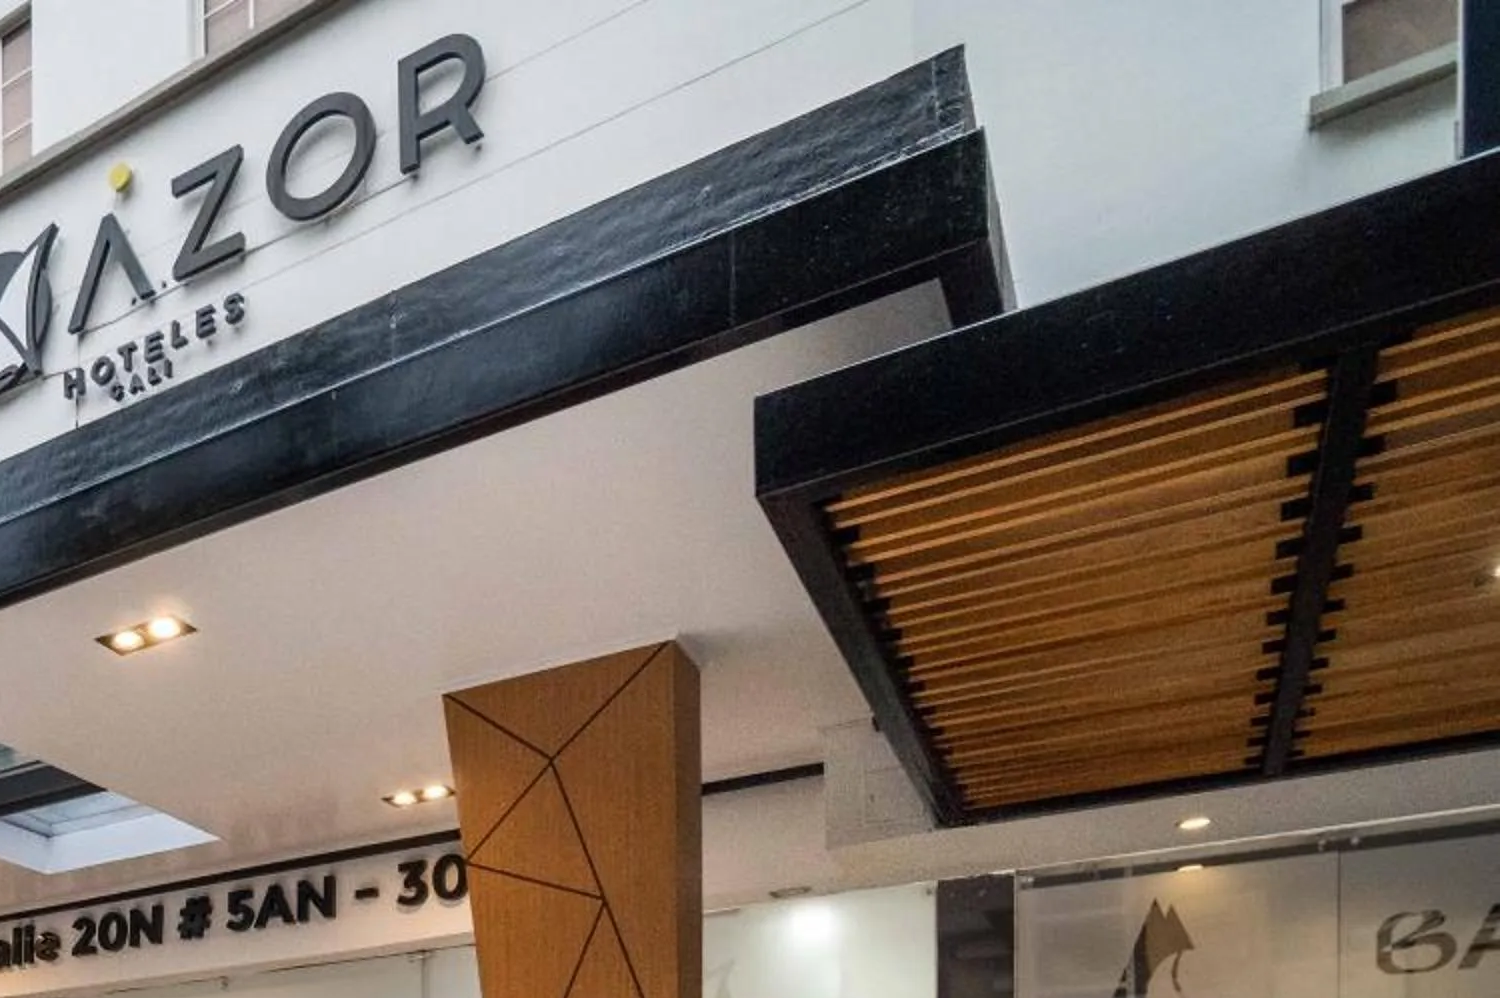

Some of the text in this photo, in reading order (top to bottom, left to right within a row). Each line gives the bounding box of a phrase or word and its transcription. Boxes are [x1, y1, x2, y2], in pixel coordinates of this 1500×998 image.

[64, 293, 245, 399] HOTELES
[110, 358, 173, 401] CALI
[71, 904, 164, 958] 20N
[177, 897, 212, 940] #
[226, 874, 337, 932] 5AN
[397, 853, 469, 908] 30
